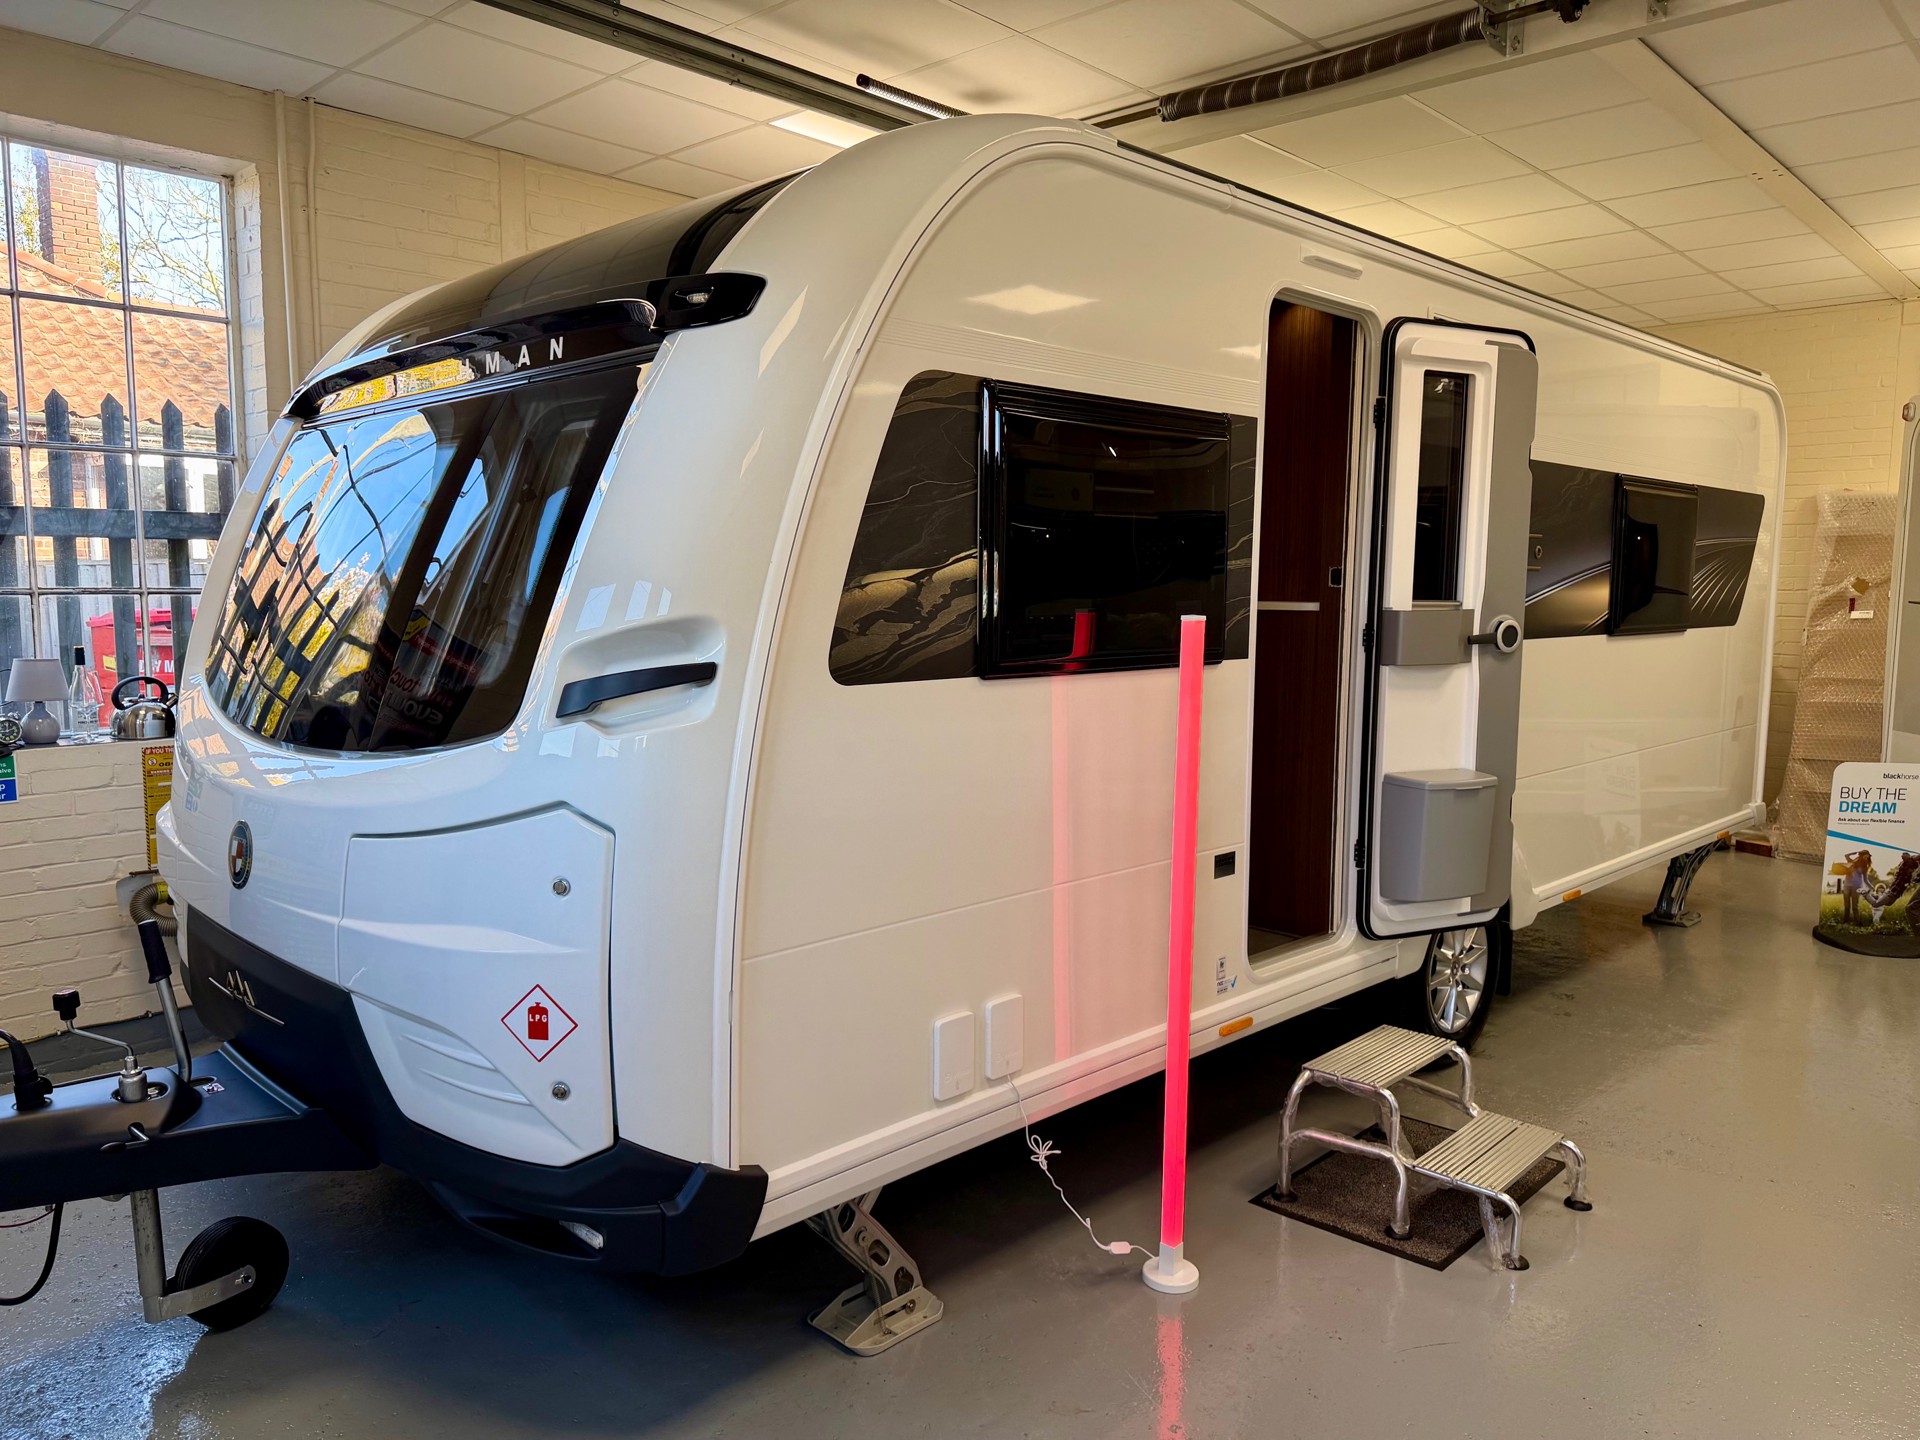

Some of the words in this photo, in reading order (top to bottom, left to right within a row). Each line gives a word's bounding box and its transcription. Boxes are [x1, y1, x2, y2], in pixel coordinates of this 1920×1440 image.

[363, 336, 565, 402] ACHMAN
[1883, 772, 1920, 780] blackhorse
[1839, 786, 1873, 800] BUY
[1876, 787, 1908, 801] THE
[1838, 800, 1897, 814] DREAM
[528, 1013, 548, 1023] LPG
